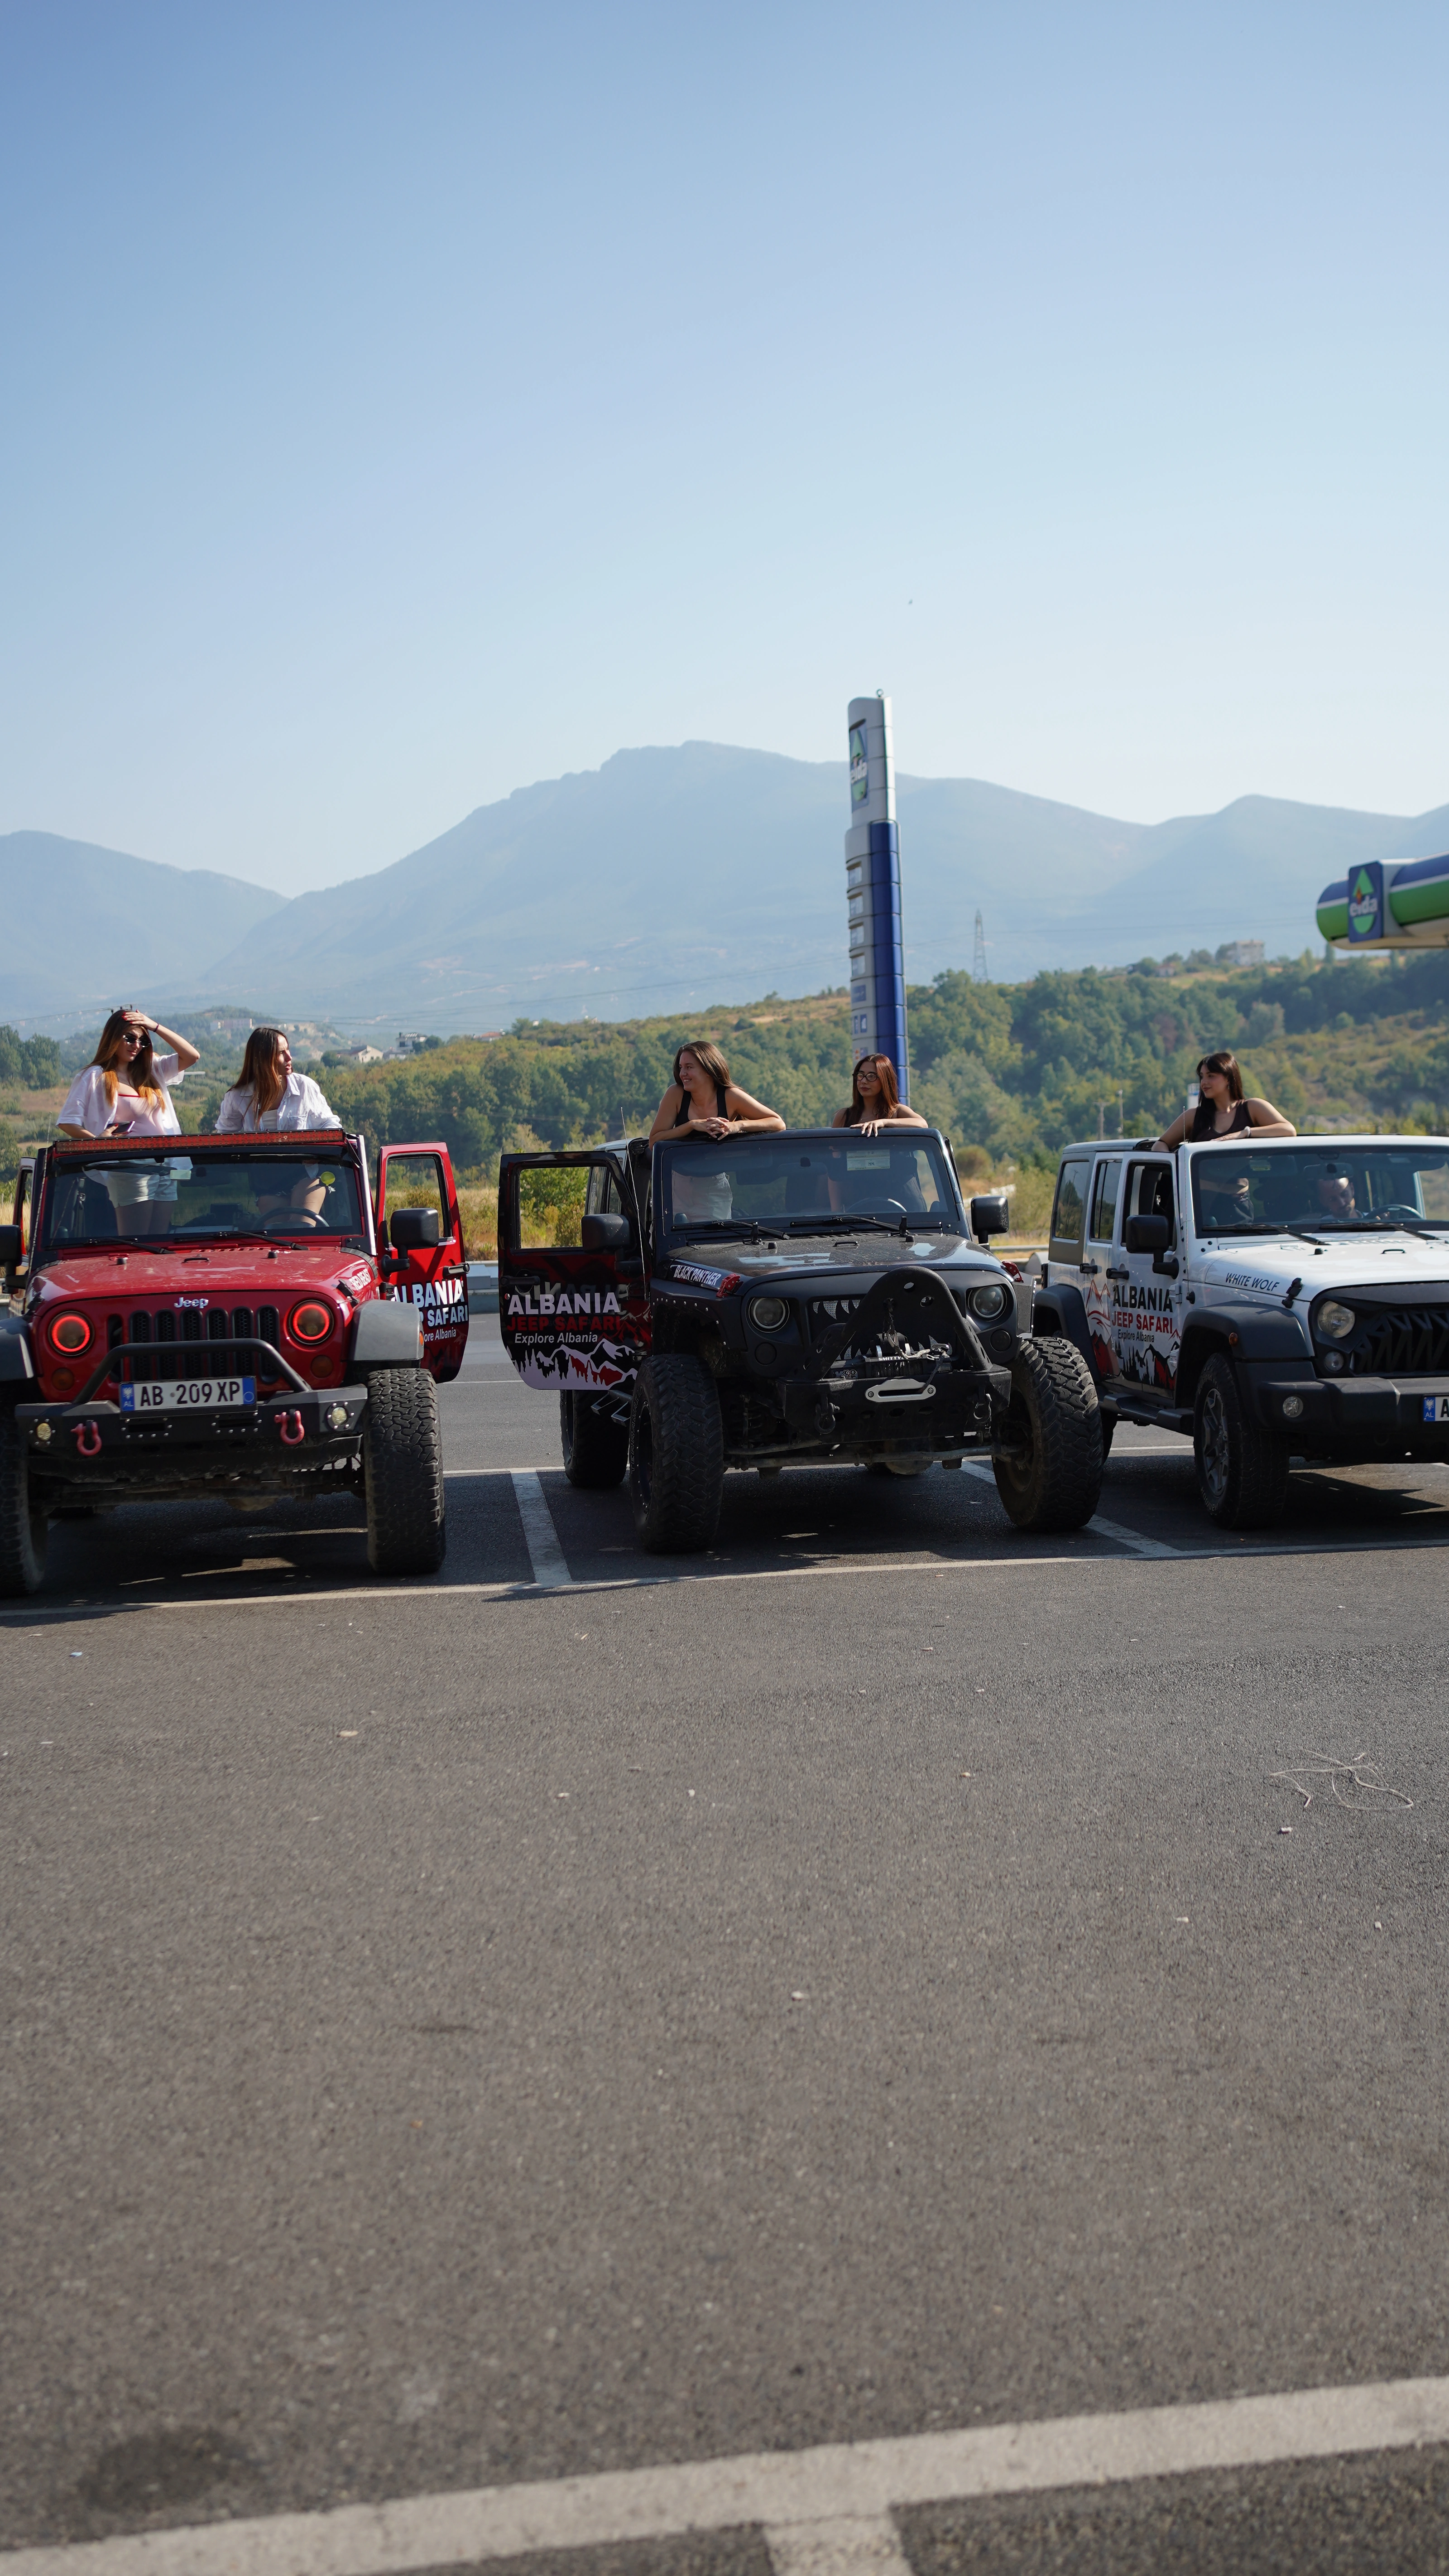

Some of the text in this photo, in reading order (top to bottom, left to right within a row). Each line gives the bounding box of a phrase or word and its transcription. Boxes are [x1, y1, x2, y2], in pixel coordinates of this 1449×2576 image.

[348, 1275, 364, 1290] RED
[673, 1265, 722, 1286] BLACK PANTHER
[1225, 1272, 1280, 1291] WHITE WOLF
[174, 1297, 209, 1309] Jeep
[508, 1292, 620, 1315] ALBANIA
[1113, 1285, 1173, 1312] ALBANIA
[427, 1305, 468, 1327] SAFARI
[507, 1316, 621, 1331] JEEP SAFARI
[1112, 1311, 1173, 1334] JEEP SAFARI
[435, 1328, 456, 1340] Albania
[515, 1332, 598, 1345] Explore Albania
[1118, 1329, 1154, 1343] Explore Albania
[140, 1382, 240, 1406] AB 209 XP
